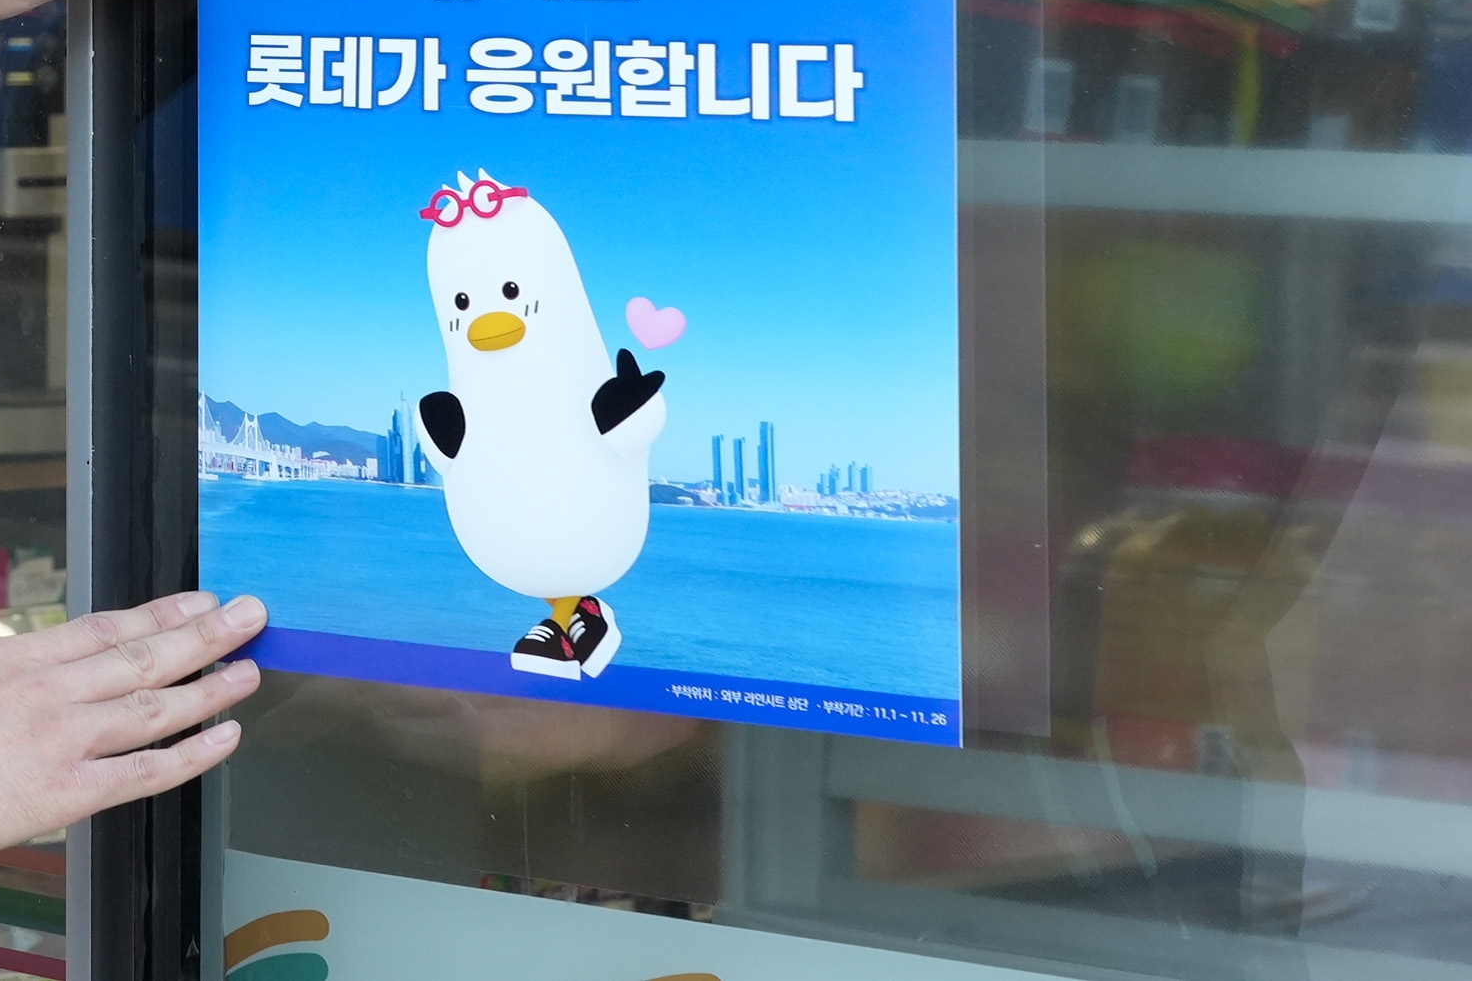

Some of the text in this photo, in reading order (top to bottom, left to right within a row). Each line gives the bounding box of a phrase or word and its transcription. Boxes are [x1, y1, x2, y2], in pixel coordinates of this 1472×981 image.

[246, 33, 864, 122] 롯데가 응원합니다
[672, 684, 713, 701] 부착위치
[720, 688, 743, 704] 외부
[787, 696, 809, 713] 상단
